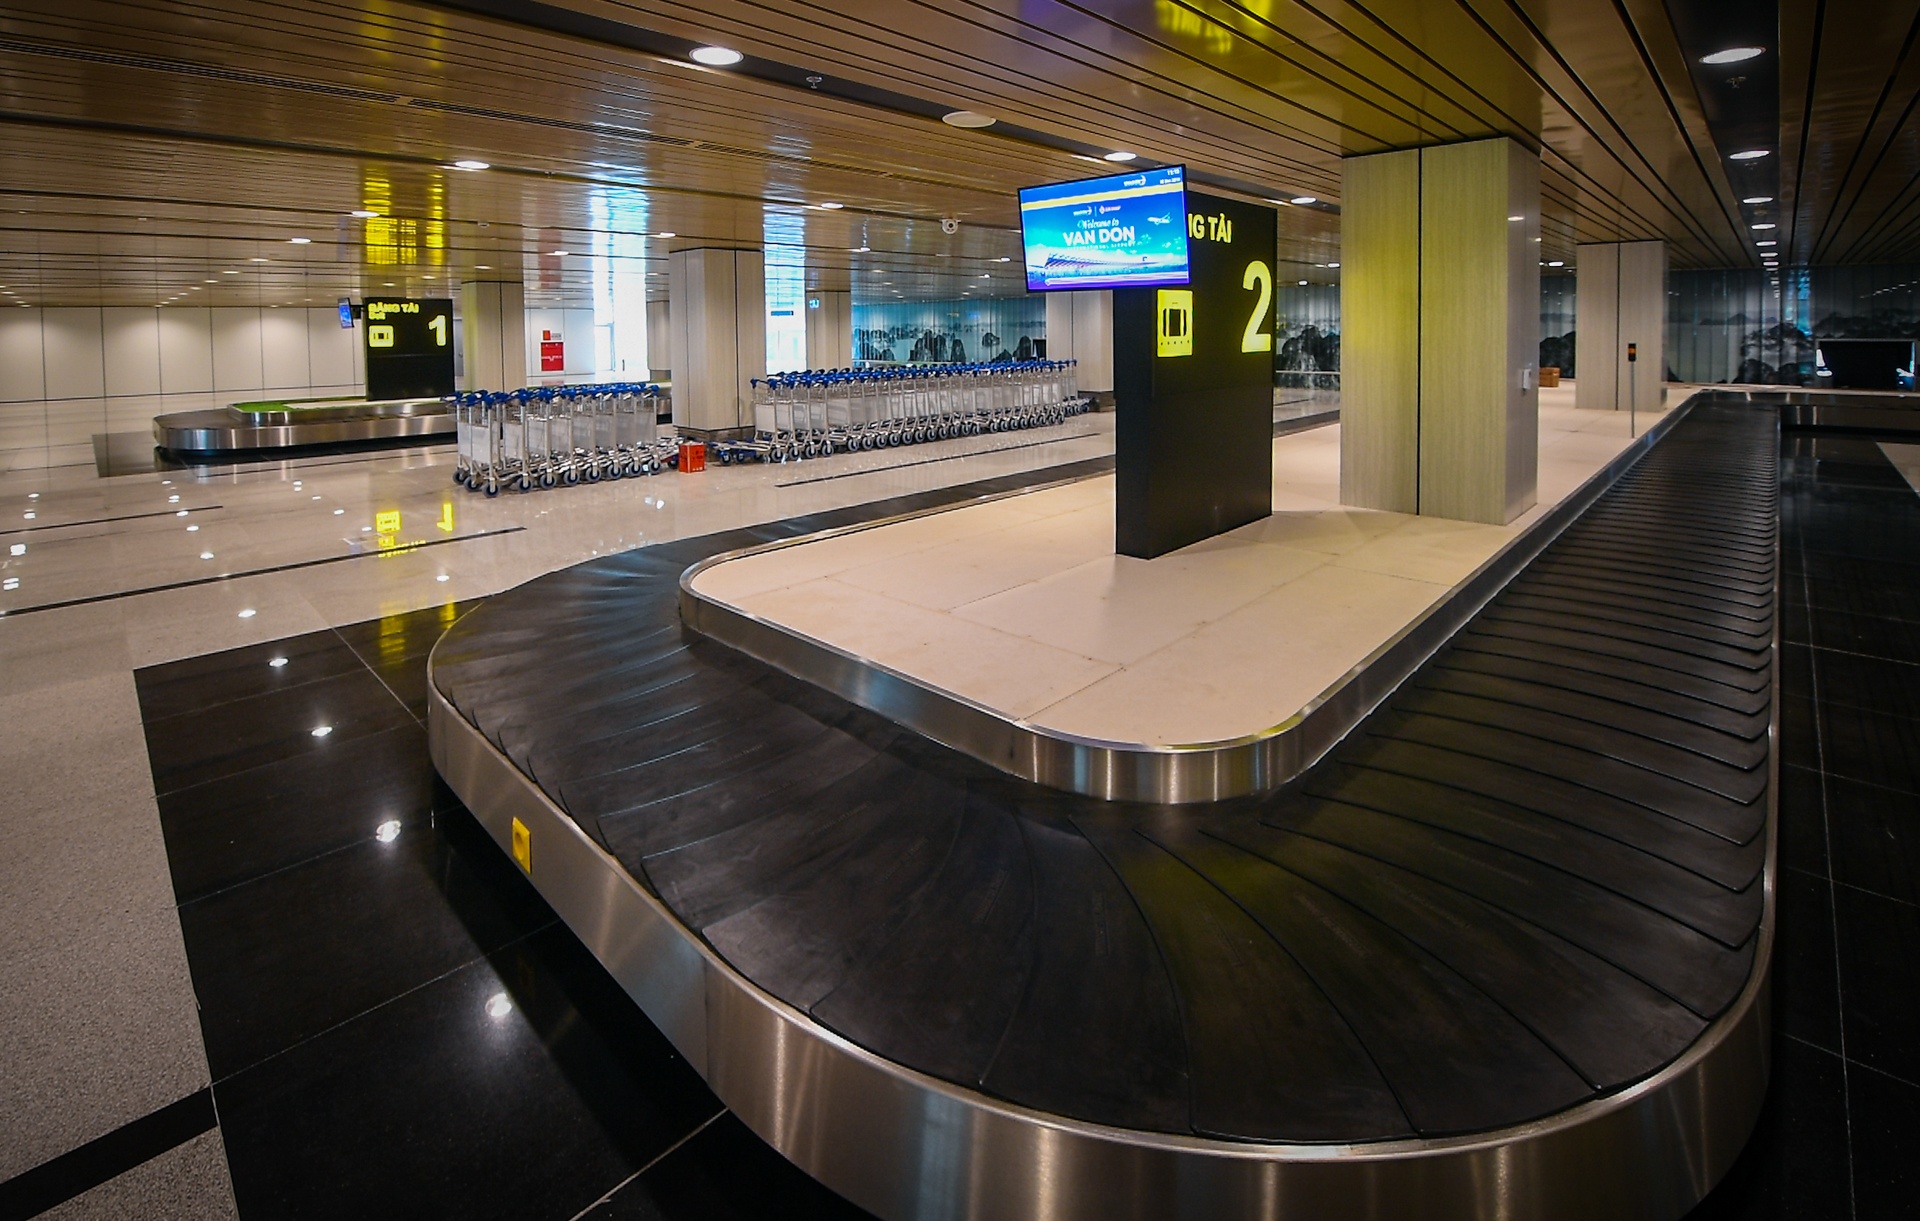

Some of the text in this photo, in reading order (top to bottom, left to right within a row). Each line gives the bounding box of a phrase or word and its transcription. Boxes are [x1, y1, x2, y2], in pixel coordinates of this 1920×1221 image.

[1062, 230, 1096, 246] VAN
[1099, 226, 1135, 243] DON
[1207, 212, 1232, 244] TẢI
[1241, 260, 1272, 354] 2
[428, 315, 446, 346] 1
